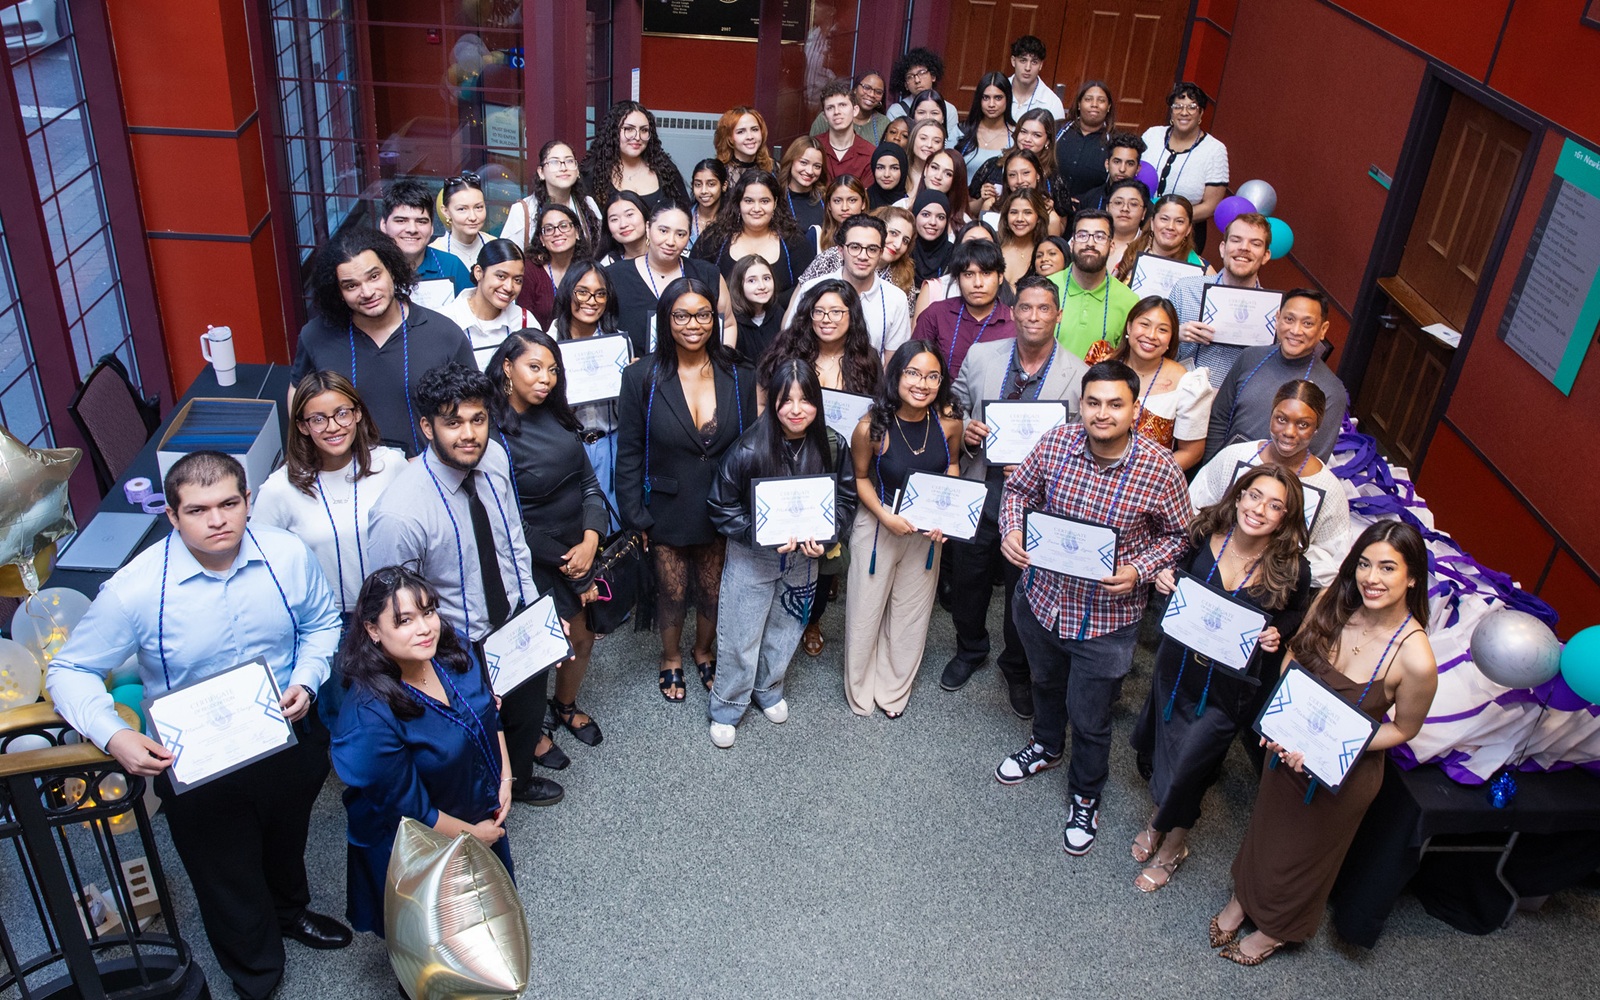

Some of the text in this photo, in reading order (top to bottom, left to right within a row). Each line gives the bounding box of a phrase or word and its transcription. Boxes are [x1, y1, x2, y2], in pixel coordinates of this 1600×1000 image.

[1574, 150, 1584, 160] 161
[1201, 600, 1234, 619] CERTIFICATE
[190, 688, 234, 709] CERTIFICATE
[1308, 696, 1340, 721] CERTIFICATE
